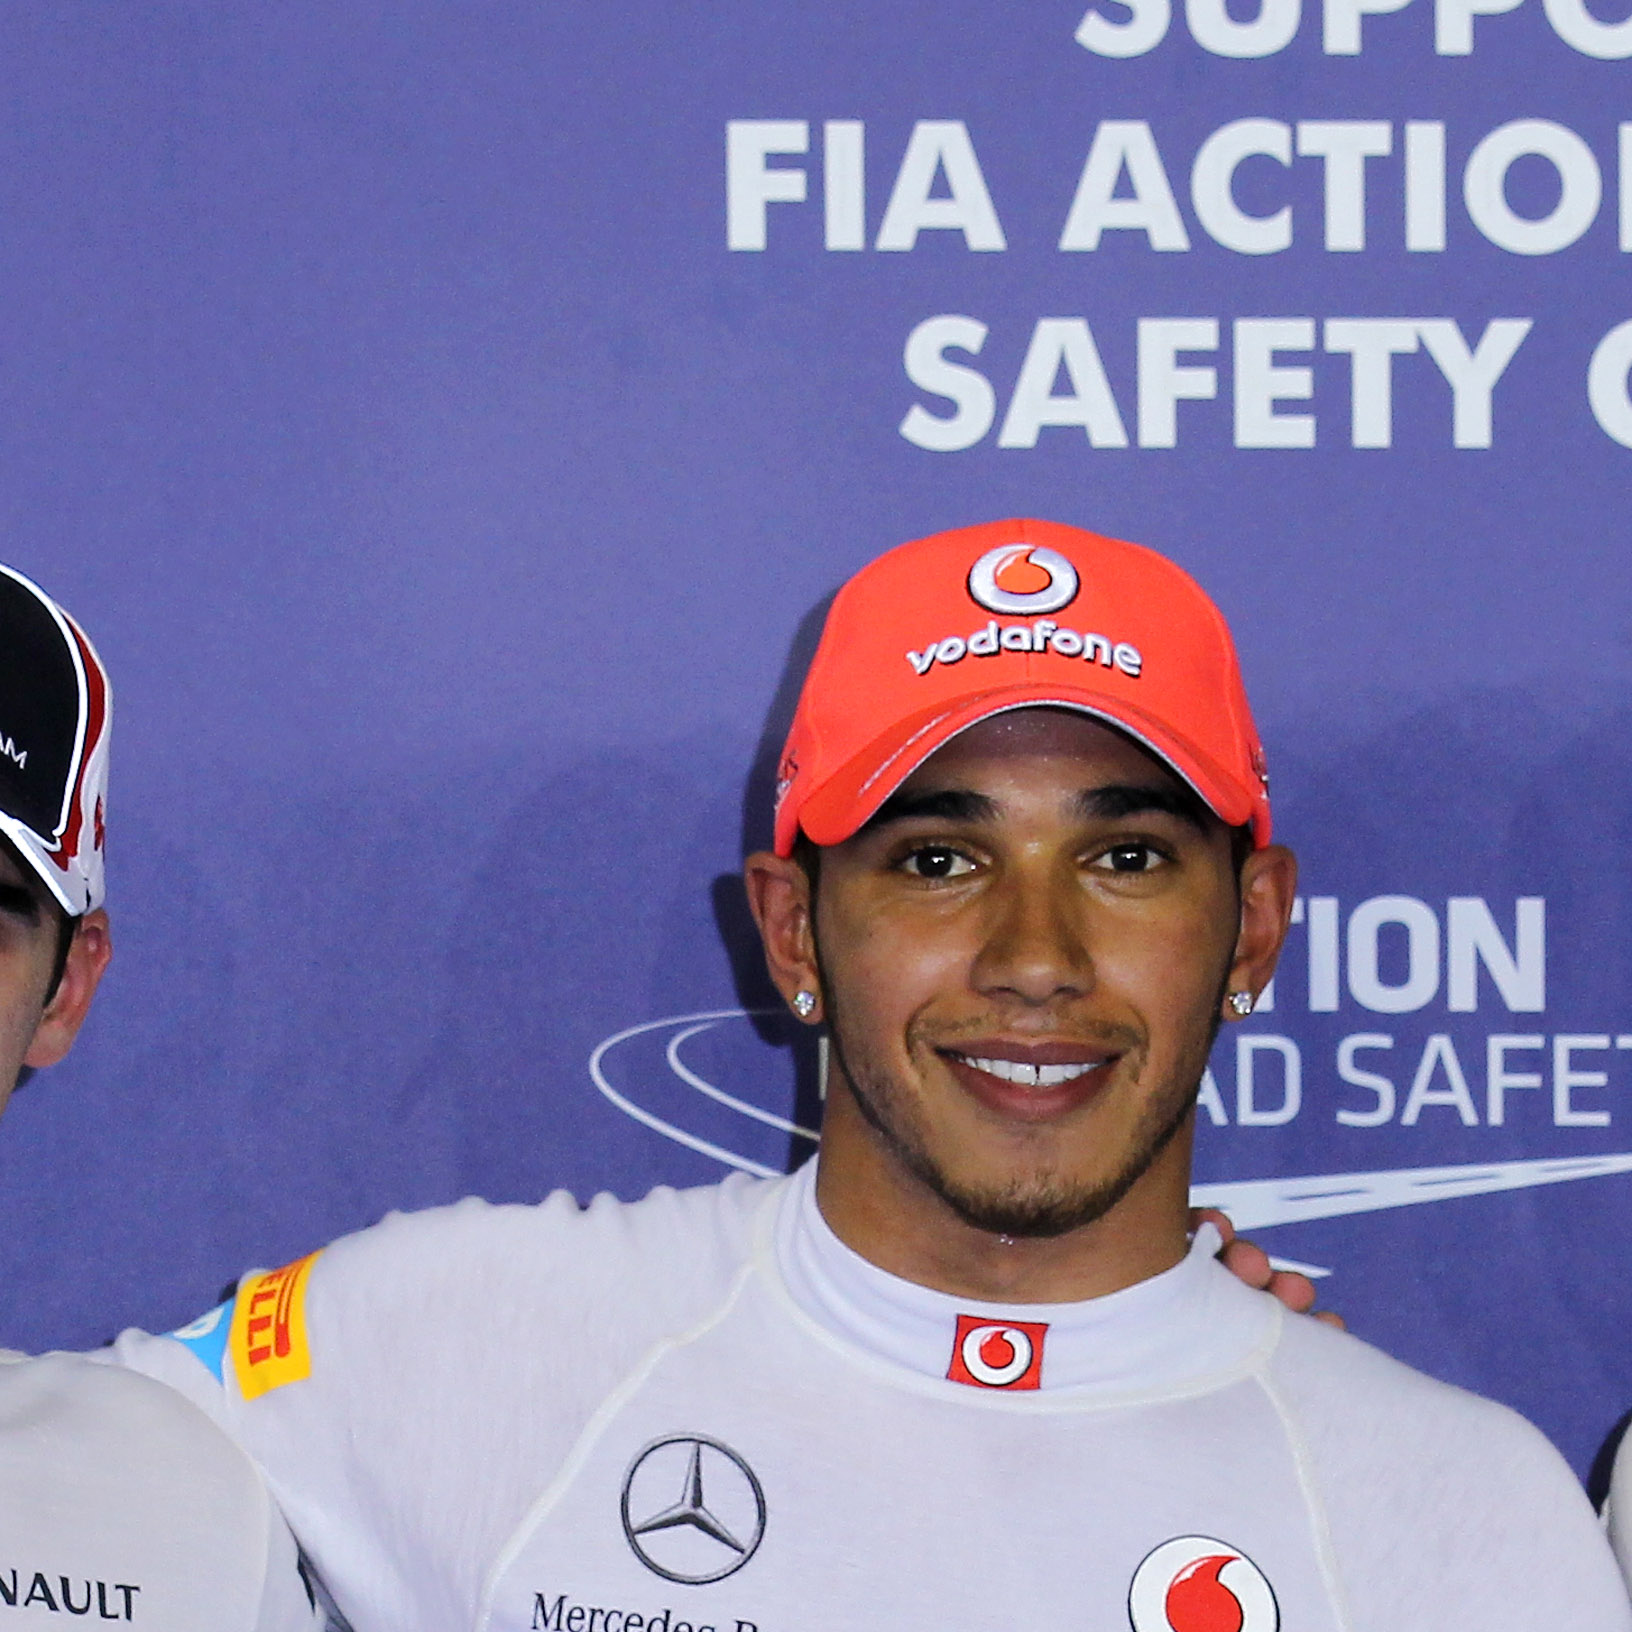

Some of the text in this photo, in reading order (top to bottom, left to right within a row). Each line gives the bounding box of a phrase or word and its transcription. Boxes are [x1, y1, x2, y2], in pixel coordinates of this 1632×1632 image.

[726, 119, 1006, 255] FIA
[898, 315, 1532, 456] SAFETY
[906, 618, 1144, 677] vodafone
